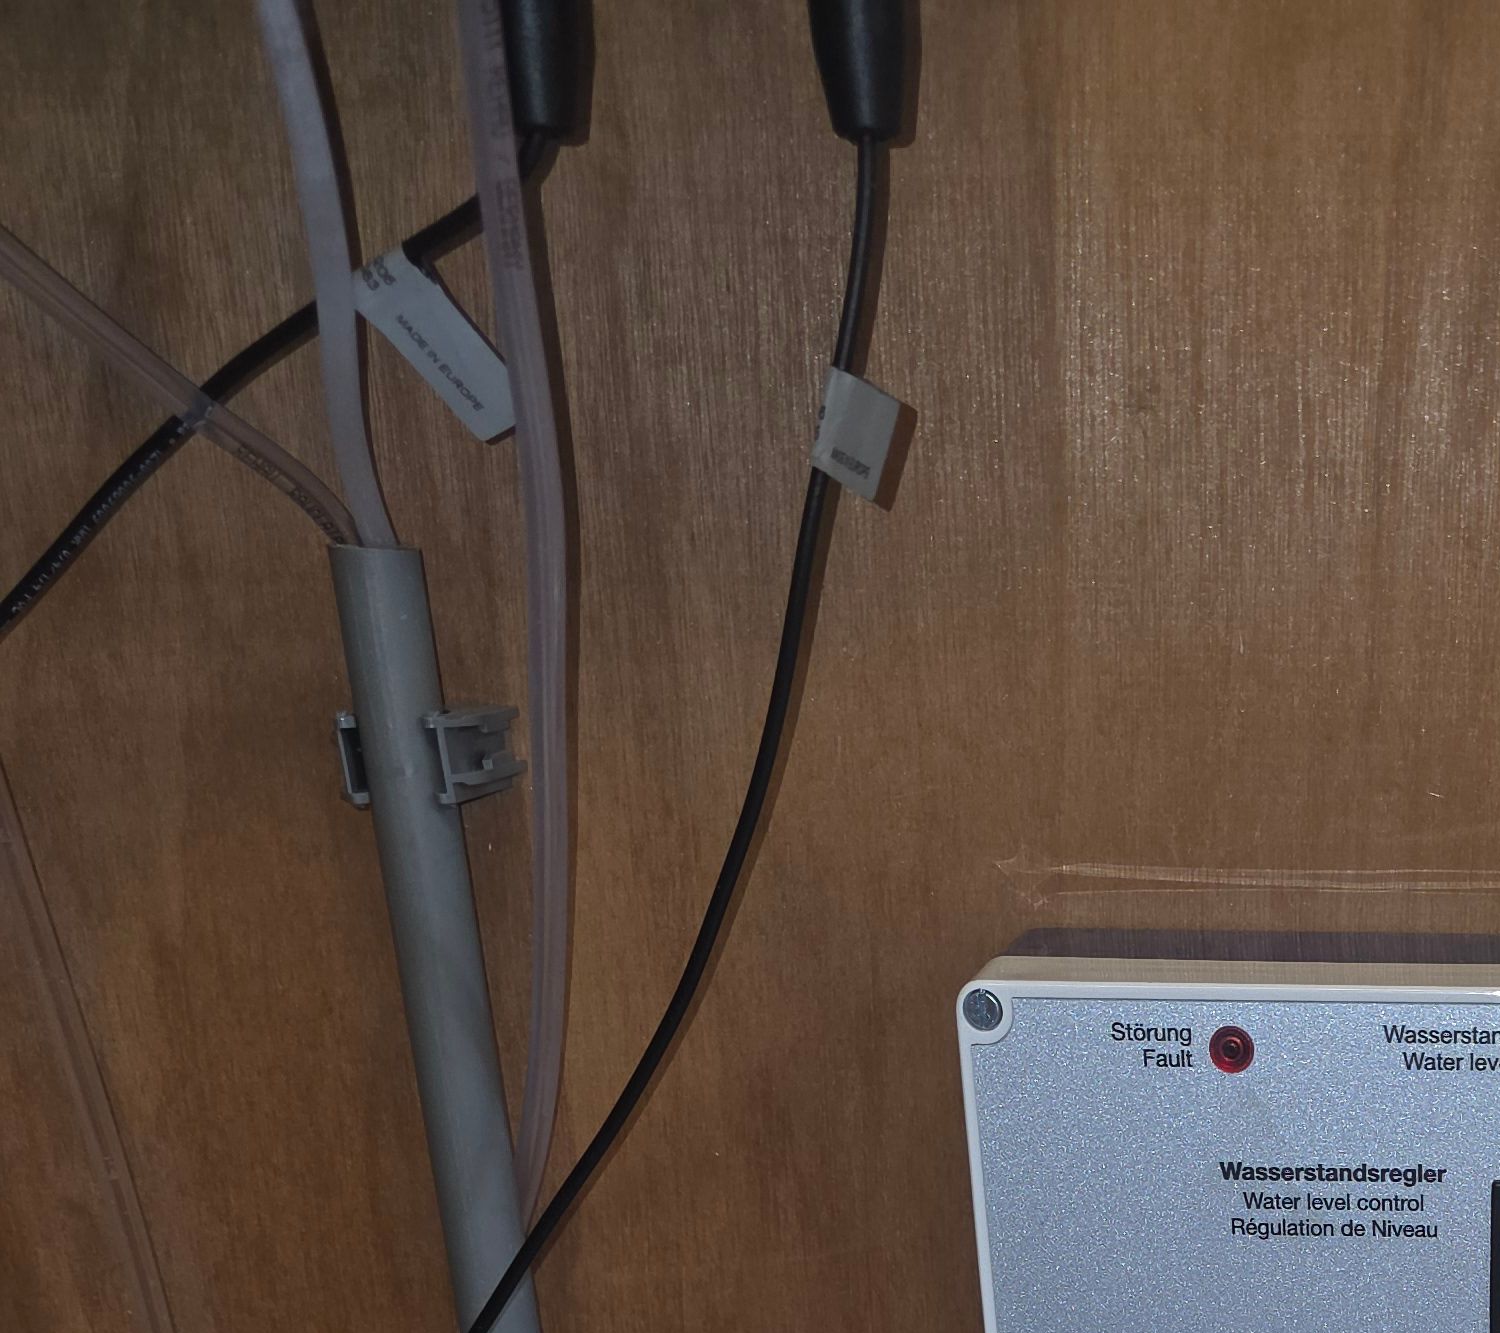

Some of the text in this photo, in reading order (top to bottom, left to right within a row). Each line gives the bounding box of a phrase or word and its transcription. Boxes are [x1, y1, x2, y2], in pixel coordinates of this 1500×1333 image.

[397, 315, 485, 412] MADE IN EUROPE
[1111, 1021, 1193, 1046] Störung
[1143, 1048, 1193, 1068] Fault
[1403, 1051, 1465, 1072] Water
[1219, 1161, 1448, 1187] Wasserstandsregler
[1243, 1191, 1425, 1212] Water level control
[1231, 1217, 1438, 1240] Régulation de Niveau
